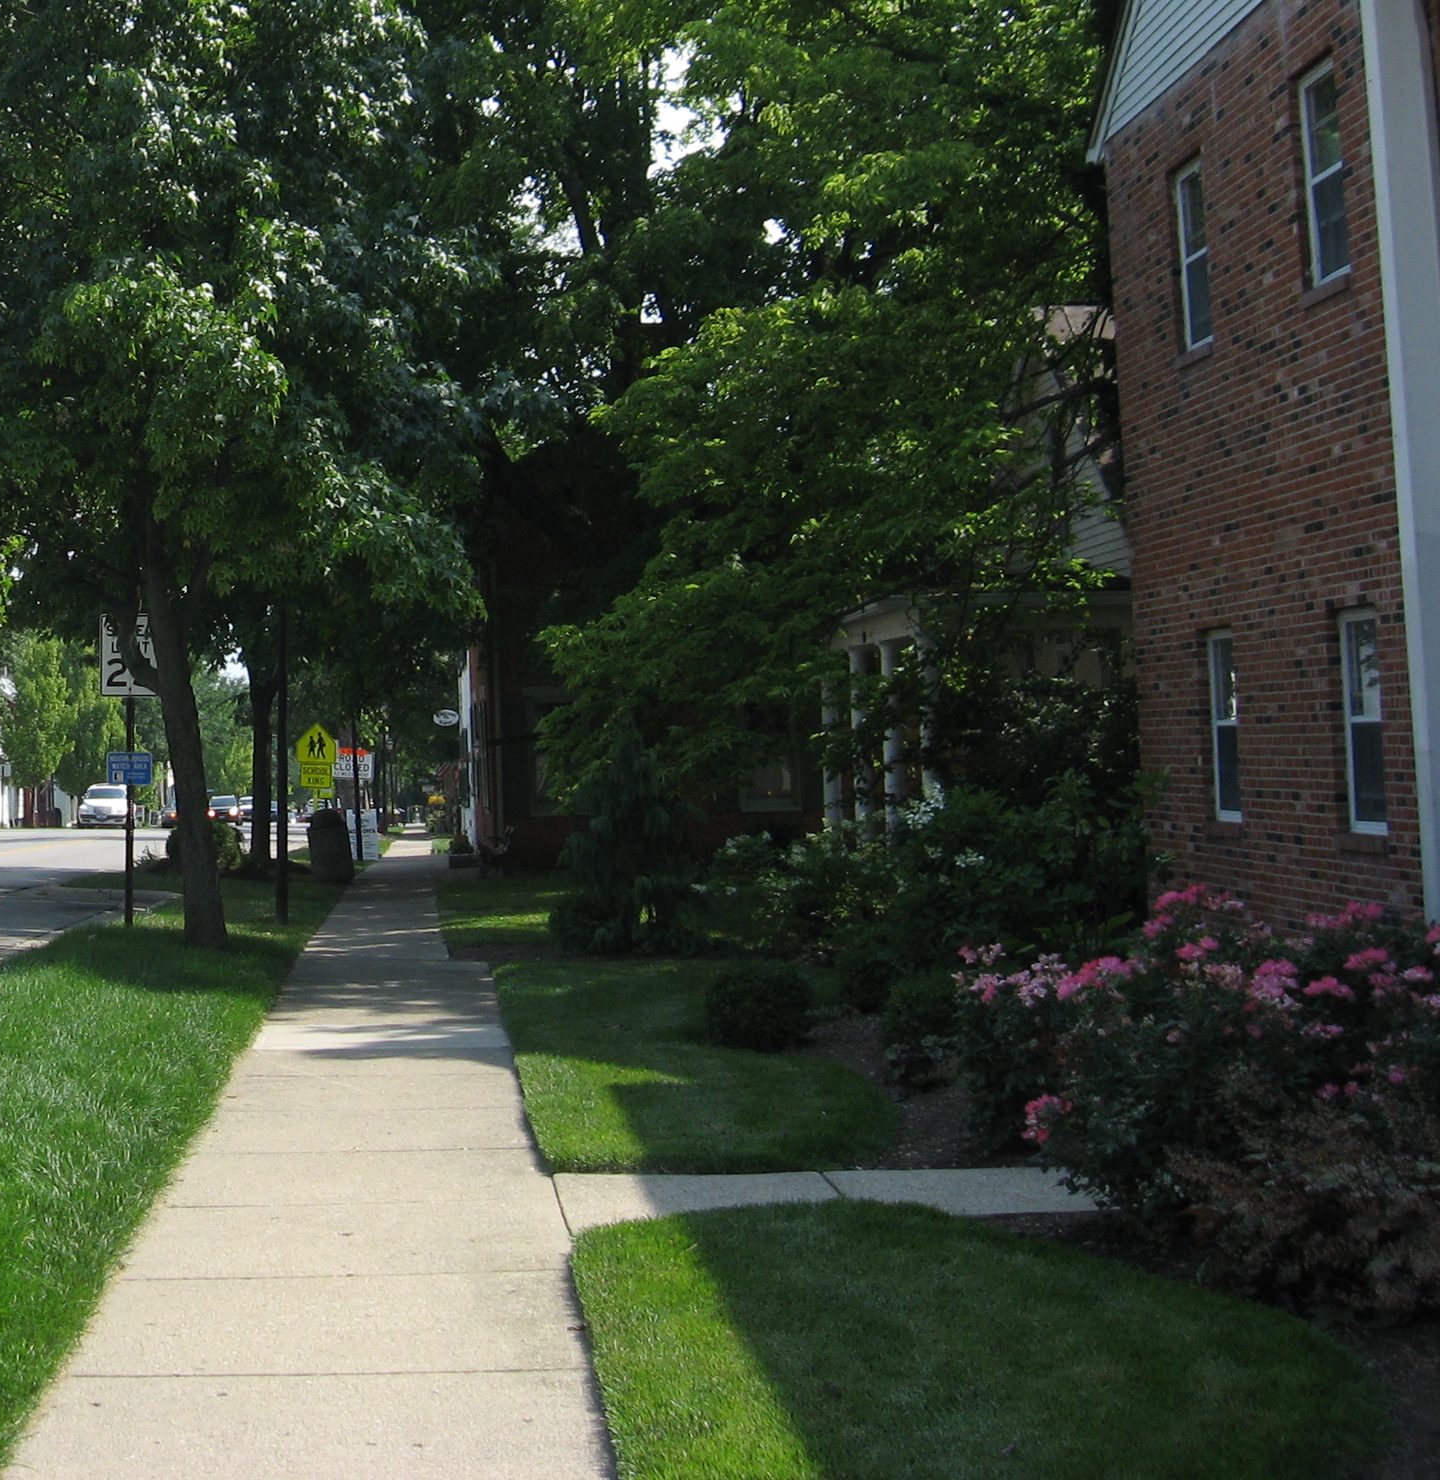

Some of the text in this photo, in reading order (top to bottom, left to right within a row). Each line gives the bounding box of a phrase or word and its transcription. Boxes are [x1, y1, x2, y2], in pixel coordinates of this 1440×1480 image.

[339, 755, 365, 763] ROD
[302, 766, 329, 776] SCHOOL
[333, 763, 370, 772] CLOED
